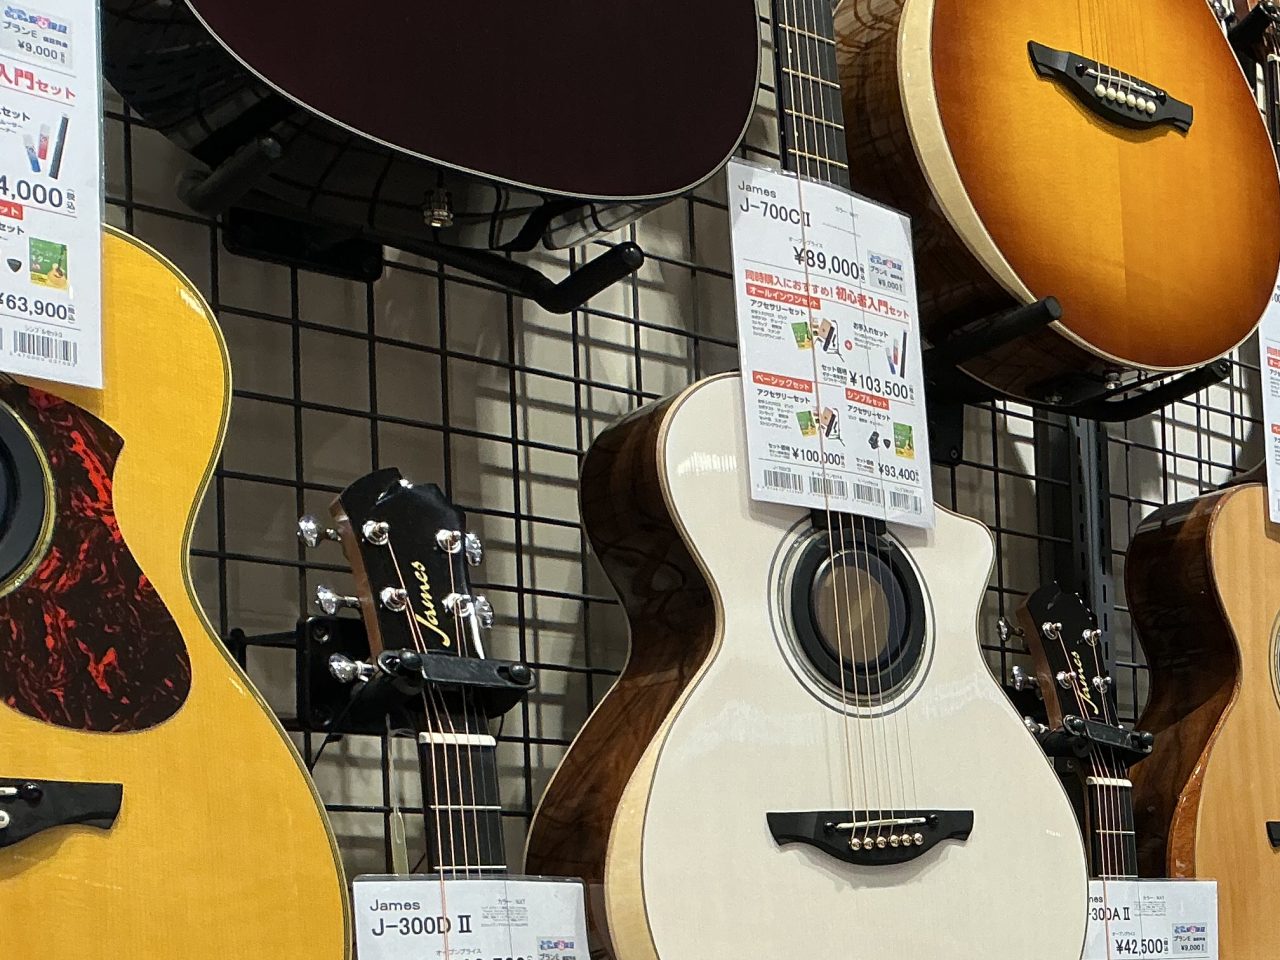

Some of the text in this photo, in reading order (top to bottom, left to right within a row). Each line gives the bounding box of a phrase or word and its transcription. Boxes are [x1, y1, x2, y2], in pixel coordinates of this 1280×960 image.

[0, 105, 31, 122] セット
[738, 181, 777, 199] James
[793, 247, 859, 280] ¥89,000
[749, 286, 819, 307] オールインワンセット
[751, 300, 806, 316] アクセサリーセット
[755, 374, 809, 390] ベーシックセット
[850, 372, 908, 399] ¥103,500
[757, 388, 810, 404] アクセサリーセット
[847, 390, 888, 408] シンプルセット
[848, 405, 890, 421] アクセサリーセット
[792, 447, 840, 465] ¥100,000
[878, 463, 916, 481] ¥93,400
[411, 560, 451, 648] James
[1071, 651, 1099, 715] James
[370, 899, 420, 912] James
[372, 916, 451, 937] J-300D
[1116, 939, 1163, 956] ¥42,500
